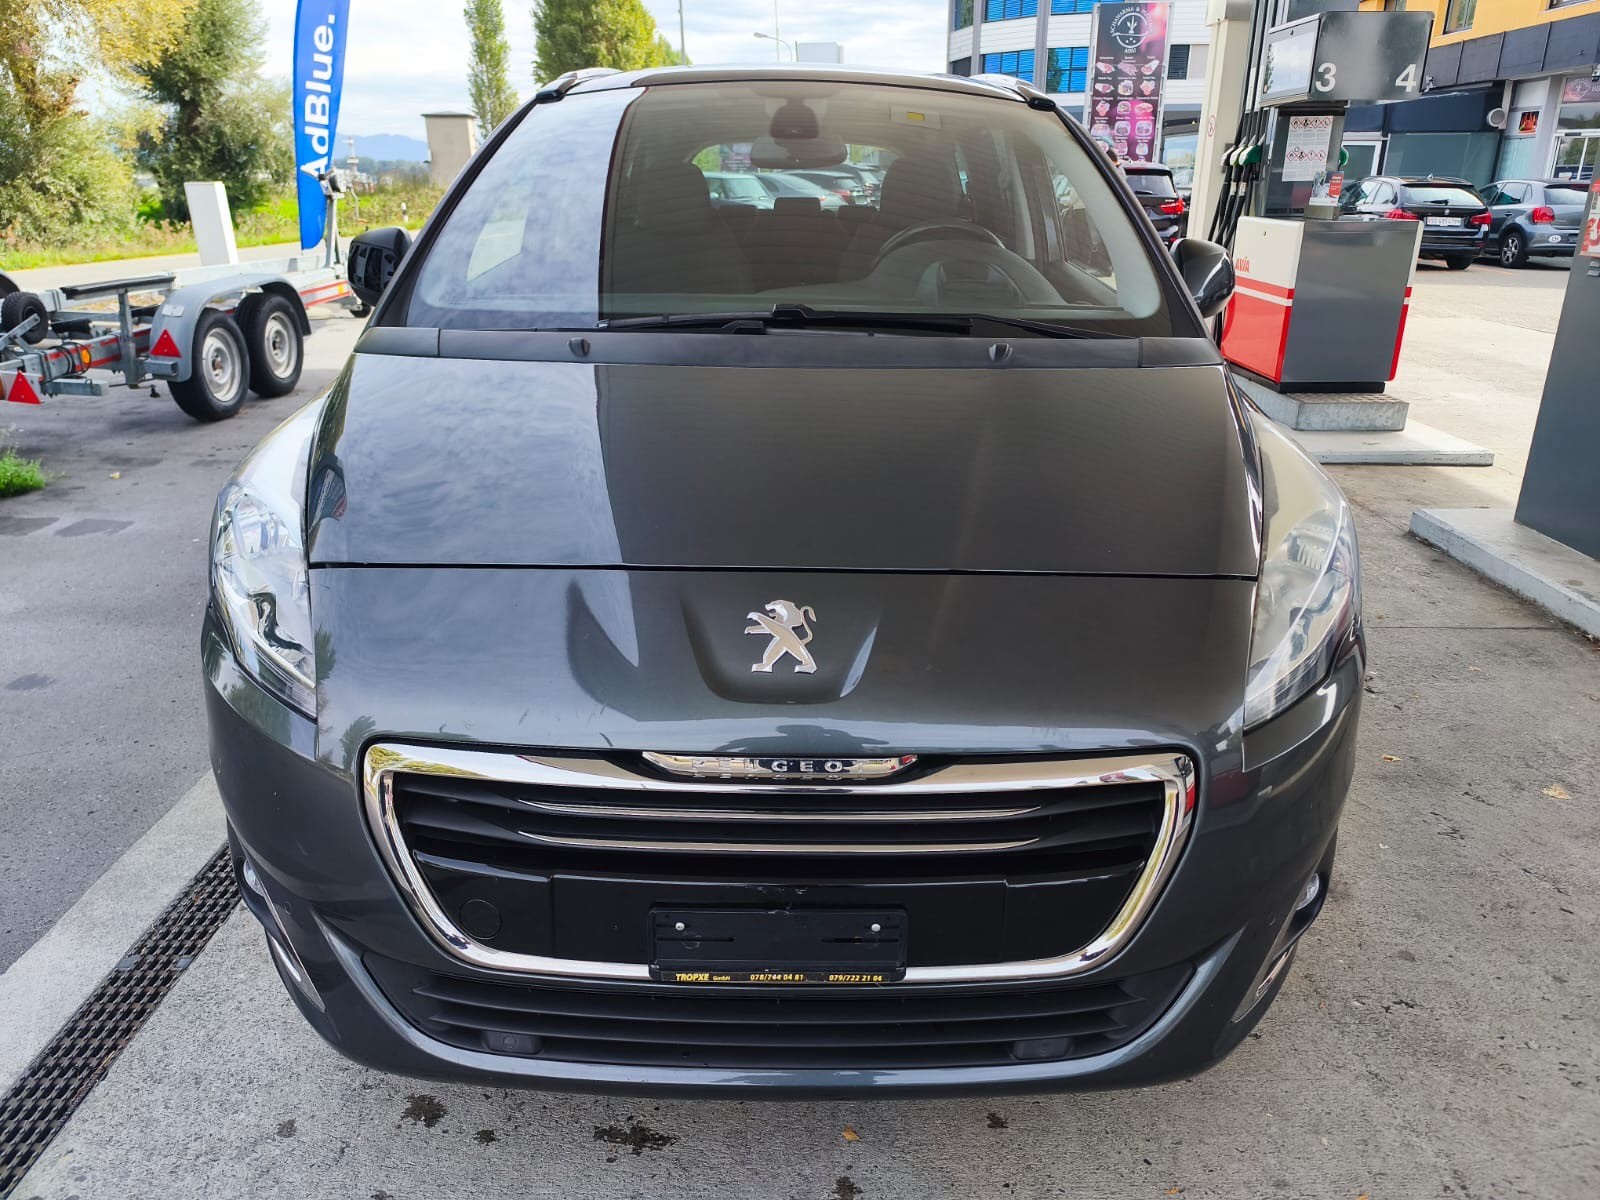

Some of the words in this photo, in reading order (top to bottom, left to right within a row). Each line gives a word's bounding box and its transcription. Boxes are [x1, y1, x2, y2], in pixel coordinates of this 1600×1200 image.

[1315, 62, 1337, 92] 3
[1395, 63, 1417, 92] 4
[675, 973, 710, 982] TROPXE
